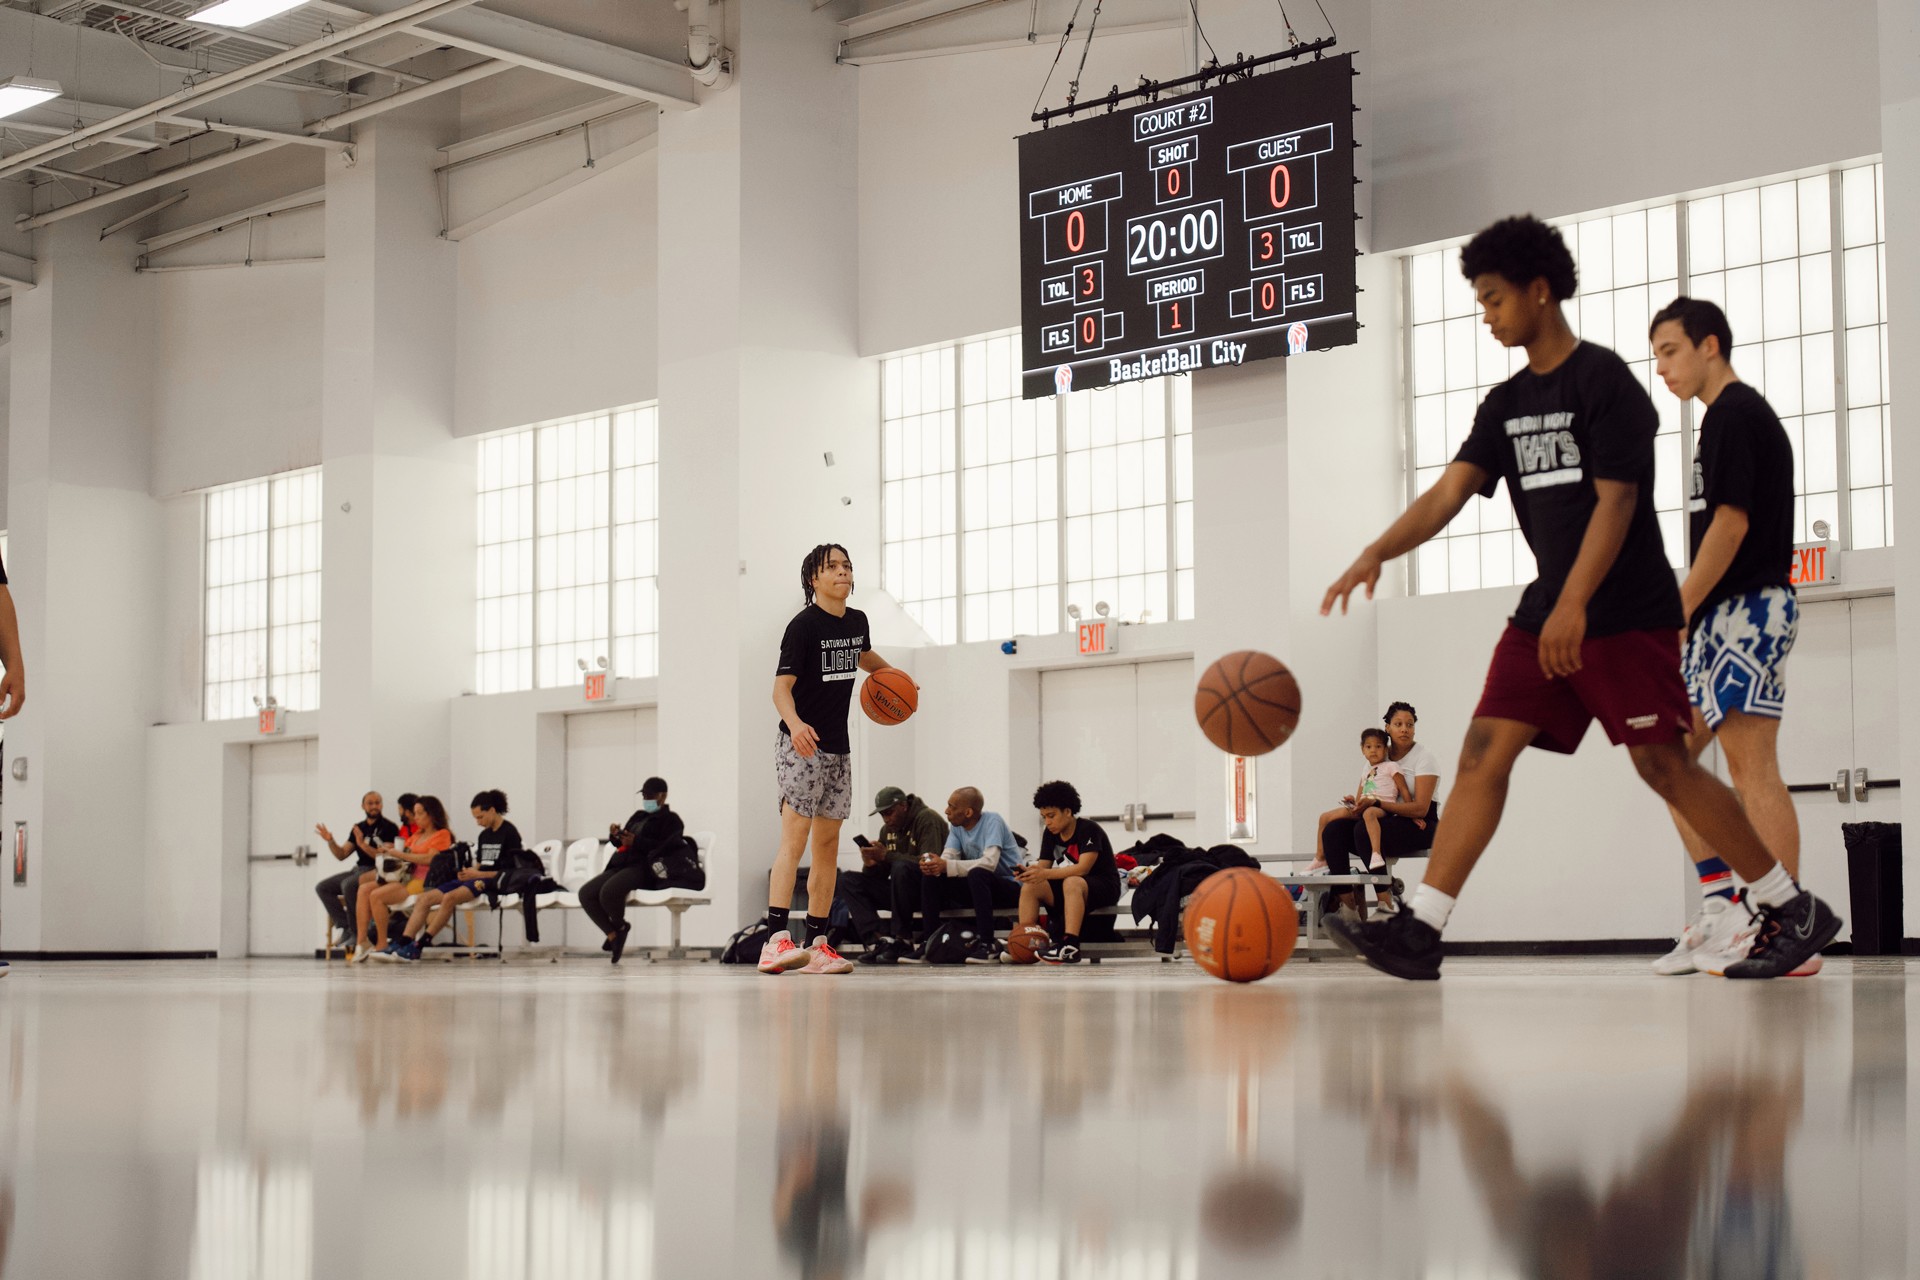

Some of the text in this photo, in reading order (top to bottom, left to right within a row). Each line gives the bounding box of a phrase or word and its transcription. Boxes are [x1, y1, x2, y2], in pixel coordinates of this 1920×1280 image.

[1140, 103, 1207, 135] COURT #2
[1158, 143, 1189, 163] SHOT
[1258, 135, 1301, 159] GUEST
[1059, 184, 1092, 205] HOME
[1167, 168, 1180, 195] 0
[1269, 164, 1291, 208] 0
[1066, 210, 1085, 252] 0
[1129, 209, 1218, 265] 20:00
[1260, 232, 1314, 260] 3 TOL
[1048, 269, 1094, 297] TOL 3
[1154, 276, 1197, 298] PERIOD
[1261, 282, 1315, 310] 0 FLS
[1171, 302, 1181, 329] 1
[1048, 316, 1095, 346] FLS 0
[1109, 340, 1246, 382] BasketBall City
[1789, 546, 1827, 584] EXIT
[821, 638, 850, 648] SATURDAY
[1080, 623, 1105, 653] EXIT
[822, 648, 862, 672] LIGHT
[586, 674, 606, 700] EXIT
